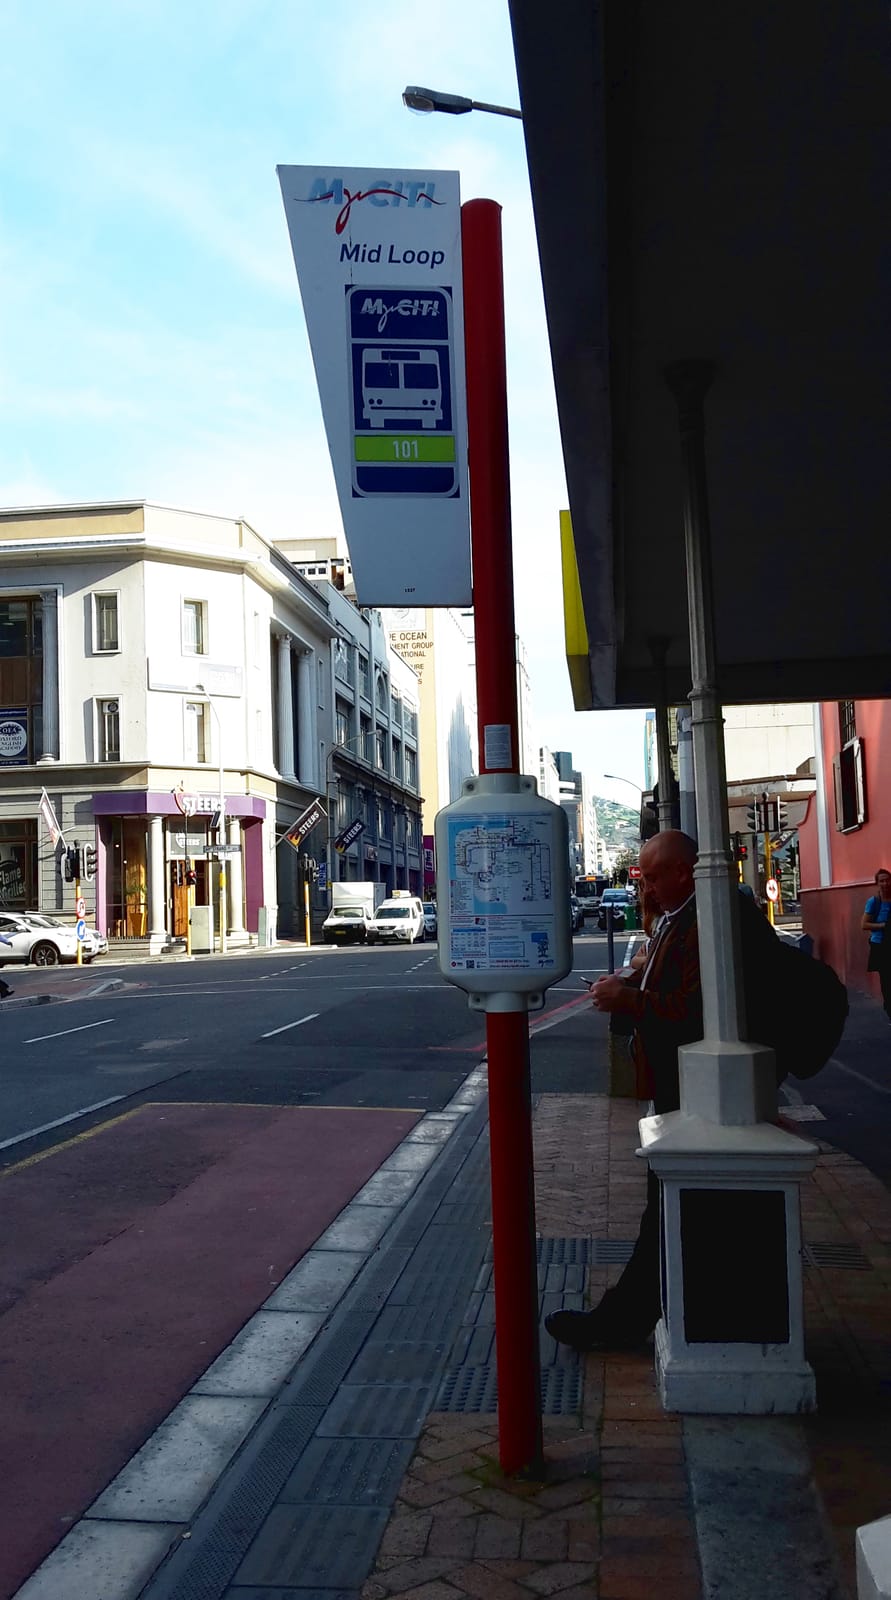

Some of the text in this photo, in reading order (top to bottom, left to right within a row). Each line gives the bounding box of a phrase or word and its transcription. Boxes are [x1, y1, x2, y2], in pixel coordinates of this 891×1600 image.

[339, 243, 445, 269] Mid Loop
[392, 440, 419, 459] 101
[399, 632, 427, 641] OCEAN
[411, 641, 434, 649] GROUP
[299, 811, 320, 834] STEERS
[343, 821, 363, 844] STEERS
